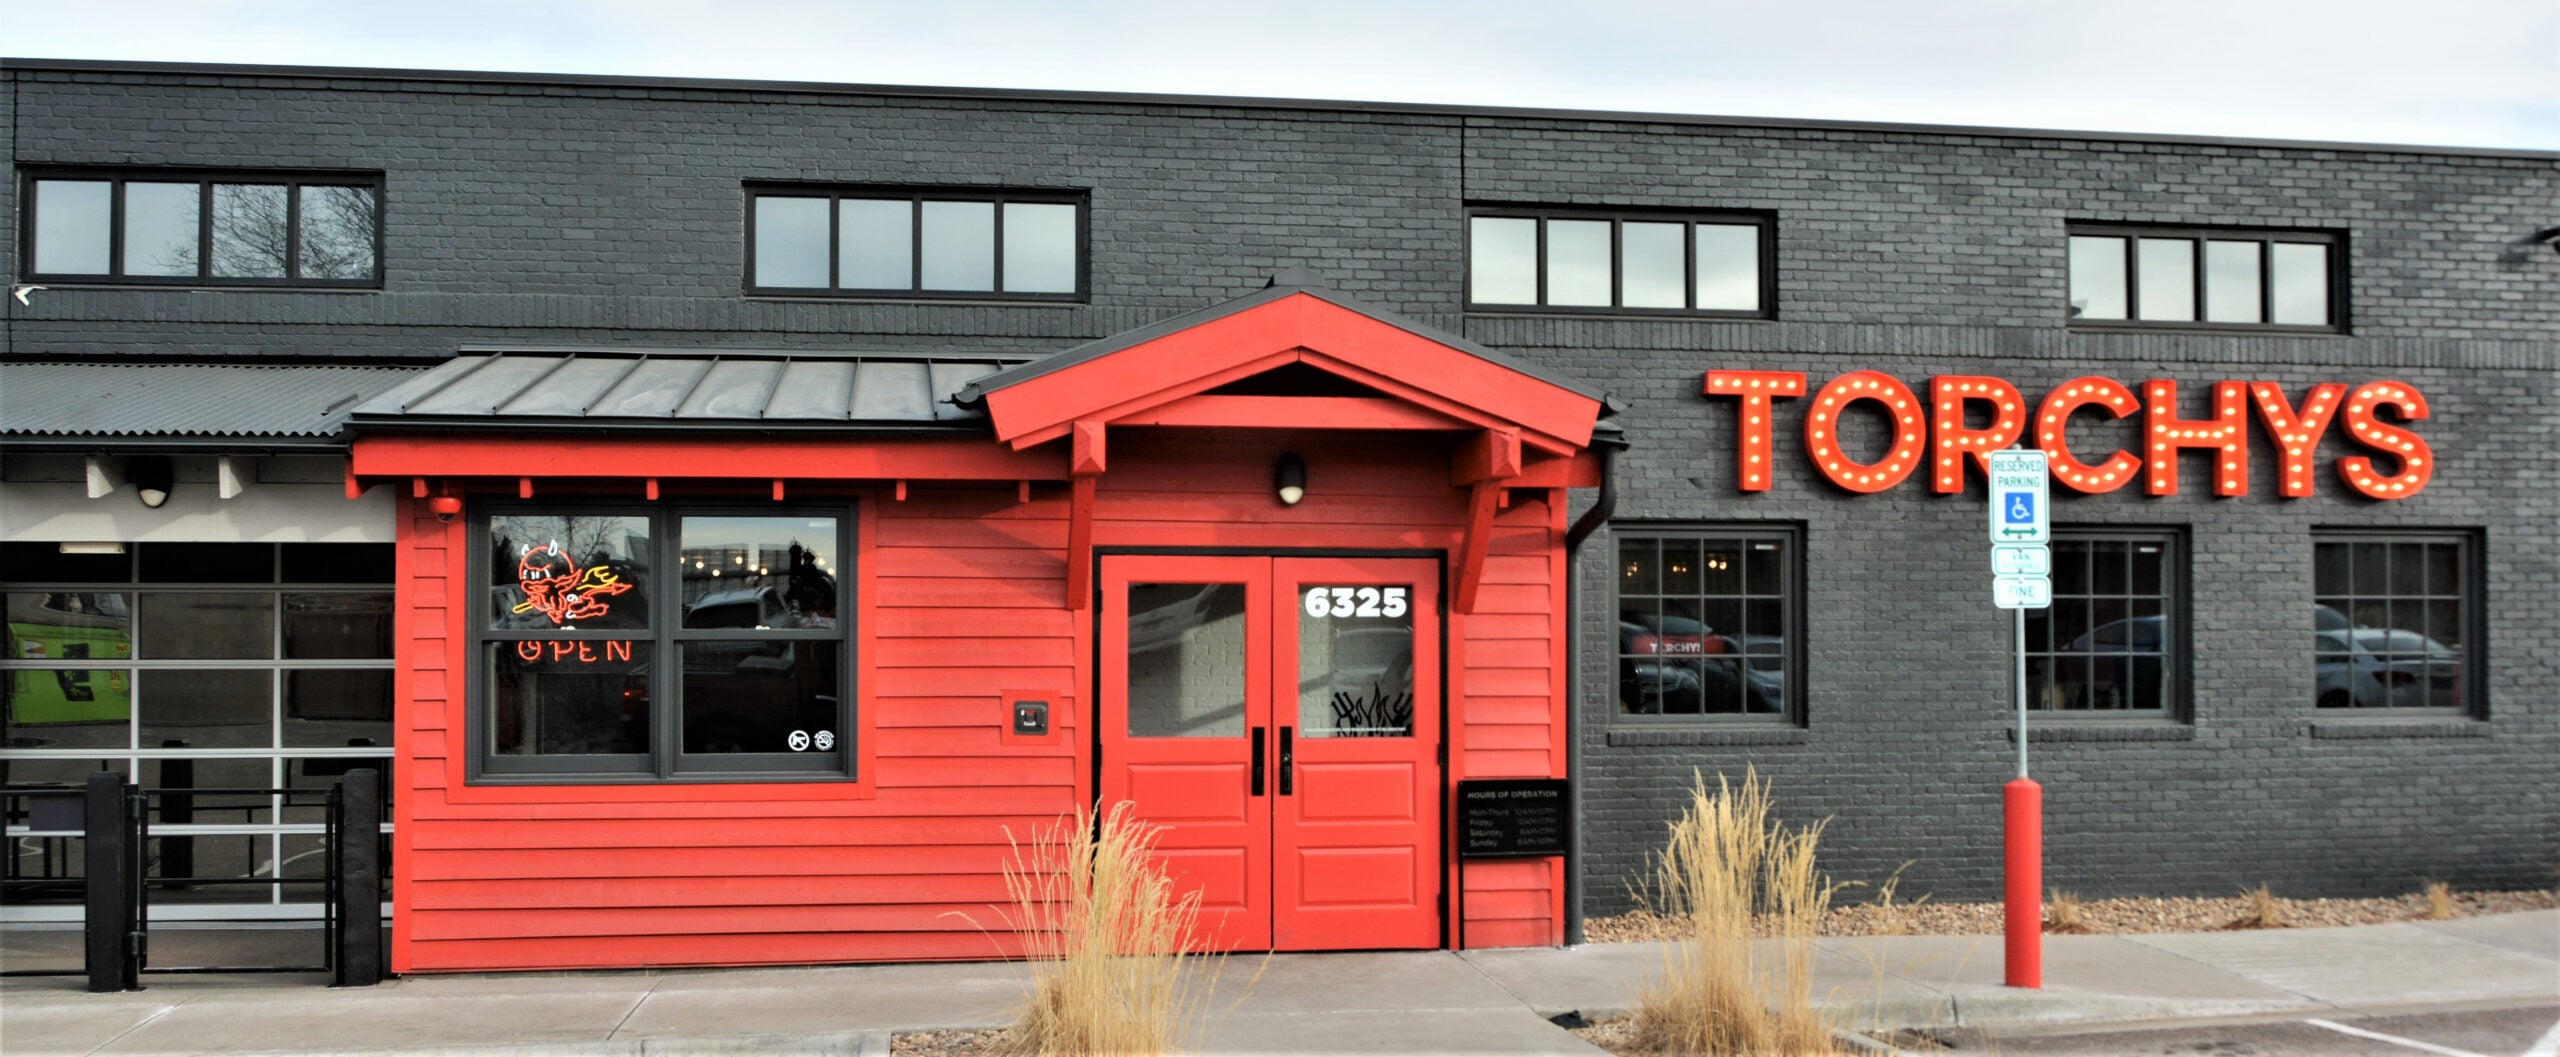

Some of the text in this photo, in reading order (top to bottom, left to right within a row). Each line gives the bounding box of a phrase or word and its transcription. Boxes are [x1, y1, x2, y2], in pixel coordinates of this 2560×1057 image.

[1704, 370, 2434, 499] TORCHYS
[1994, 460, 2043, 472] RESERVED
[1998, 476, 2041, 488] PARKING
[2008, 586, 2035, 597] FINE
[1305, 587, 1406, 618] 6325
[518, 640, 632, 662] OPEN
[1650, 643, 1701, 653] TRCHY
[1467, 790, 1558, 799] HOURS OF OPERATION
[1470, 839, 1498, 847] Sunday
